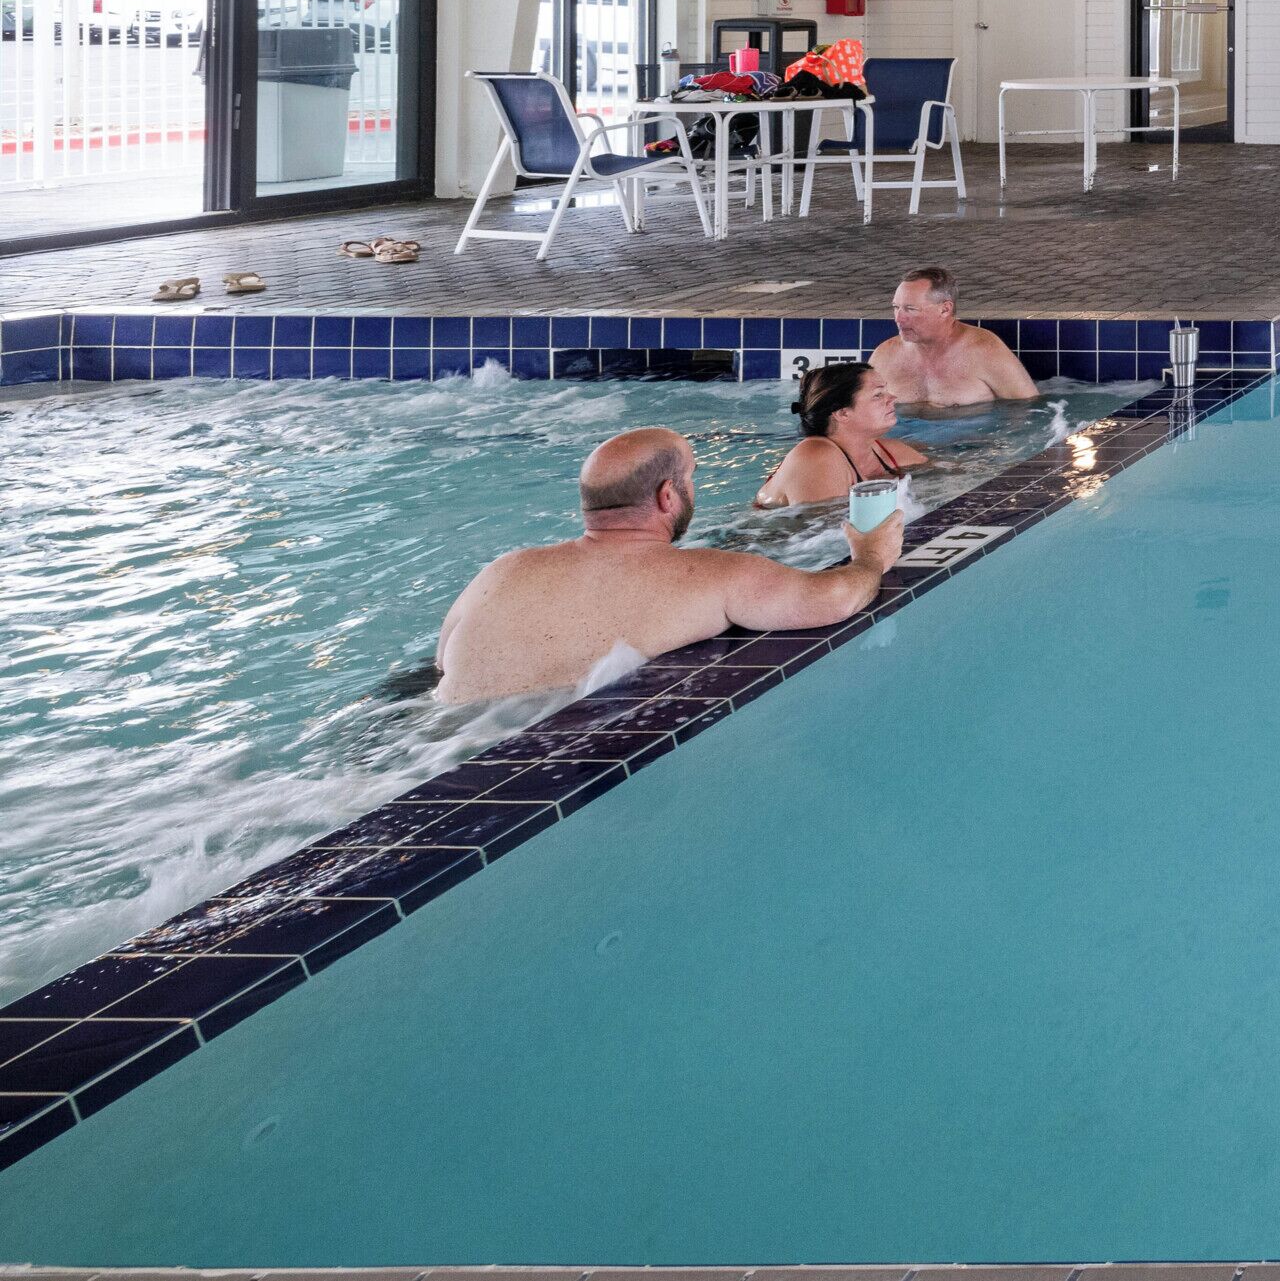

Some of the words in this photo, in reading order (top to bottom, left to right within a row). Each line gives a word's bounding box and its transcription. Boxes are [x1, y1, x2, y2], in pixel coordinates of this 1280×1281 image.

[792, 355, 810, 380] 3
[945, 531, 989, 541] 4
[904, 547, 968, 565] FT
